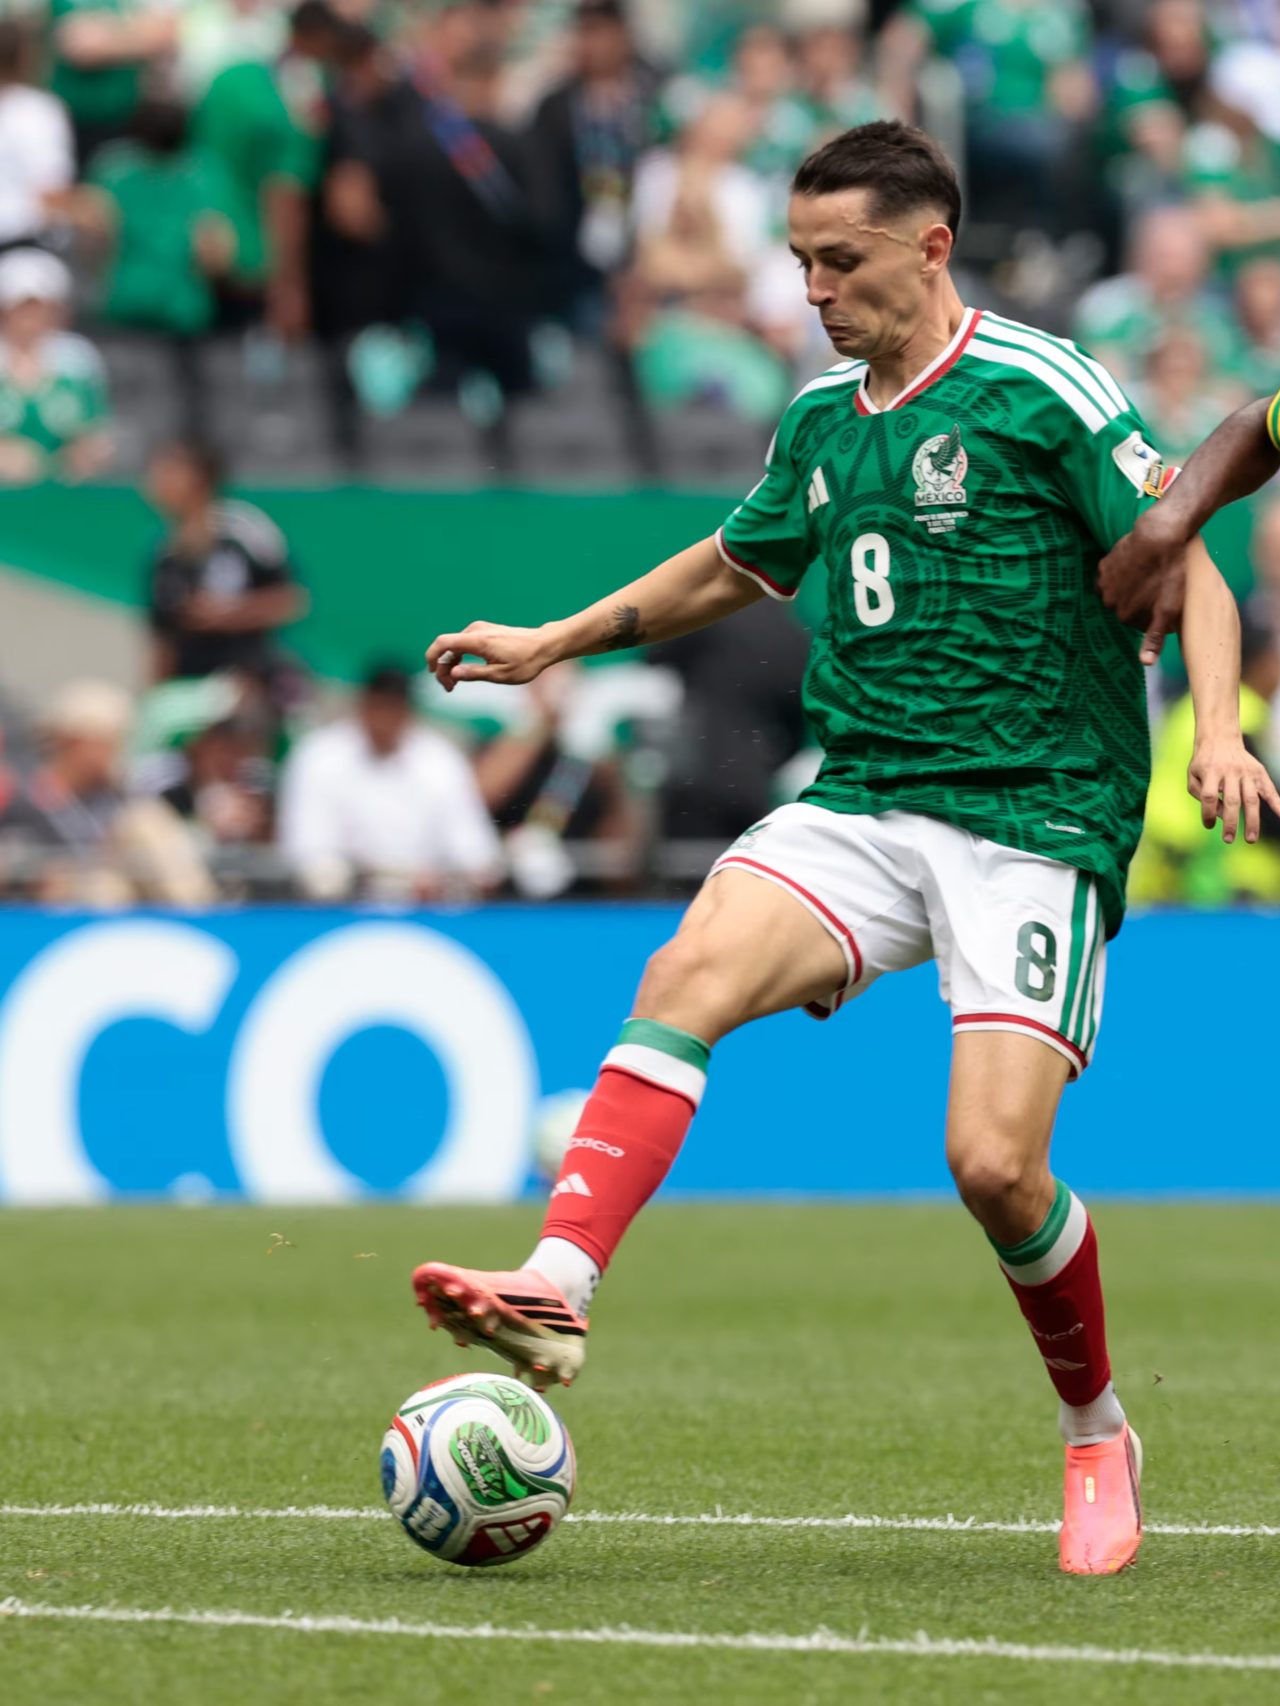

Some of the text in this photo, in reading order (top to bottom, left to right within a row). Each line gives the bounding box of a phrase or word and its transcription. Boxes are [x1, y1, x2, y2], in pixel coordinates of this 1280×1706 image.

[850, 532, 896, 627] 8
[1014, 920, 1057, 1003] 8
[0, 917, 543, 1204] CO
